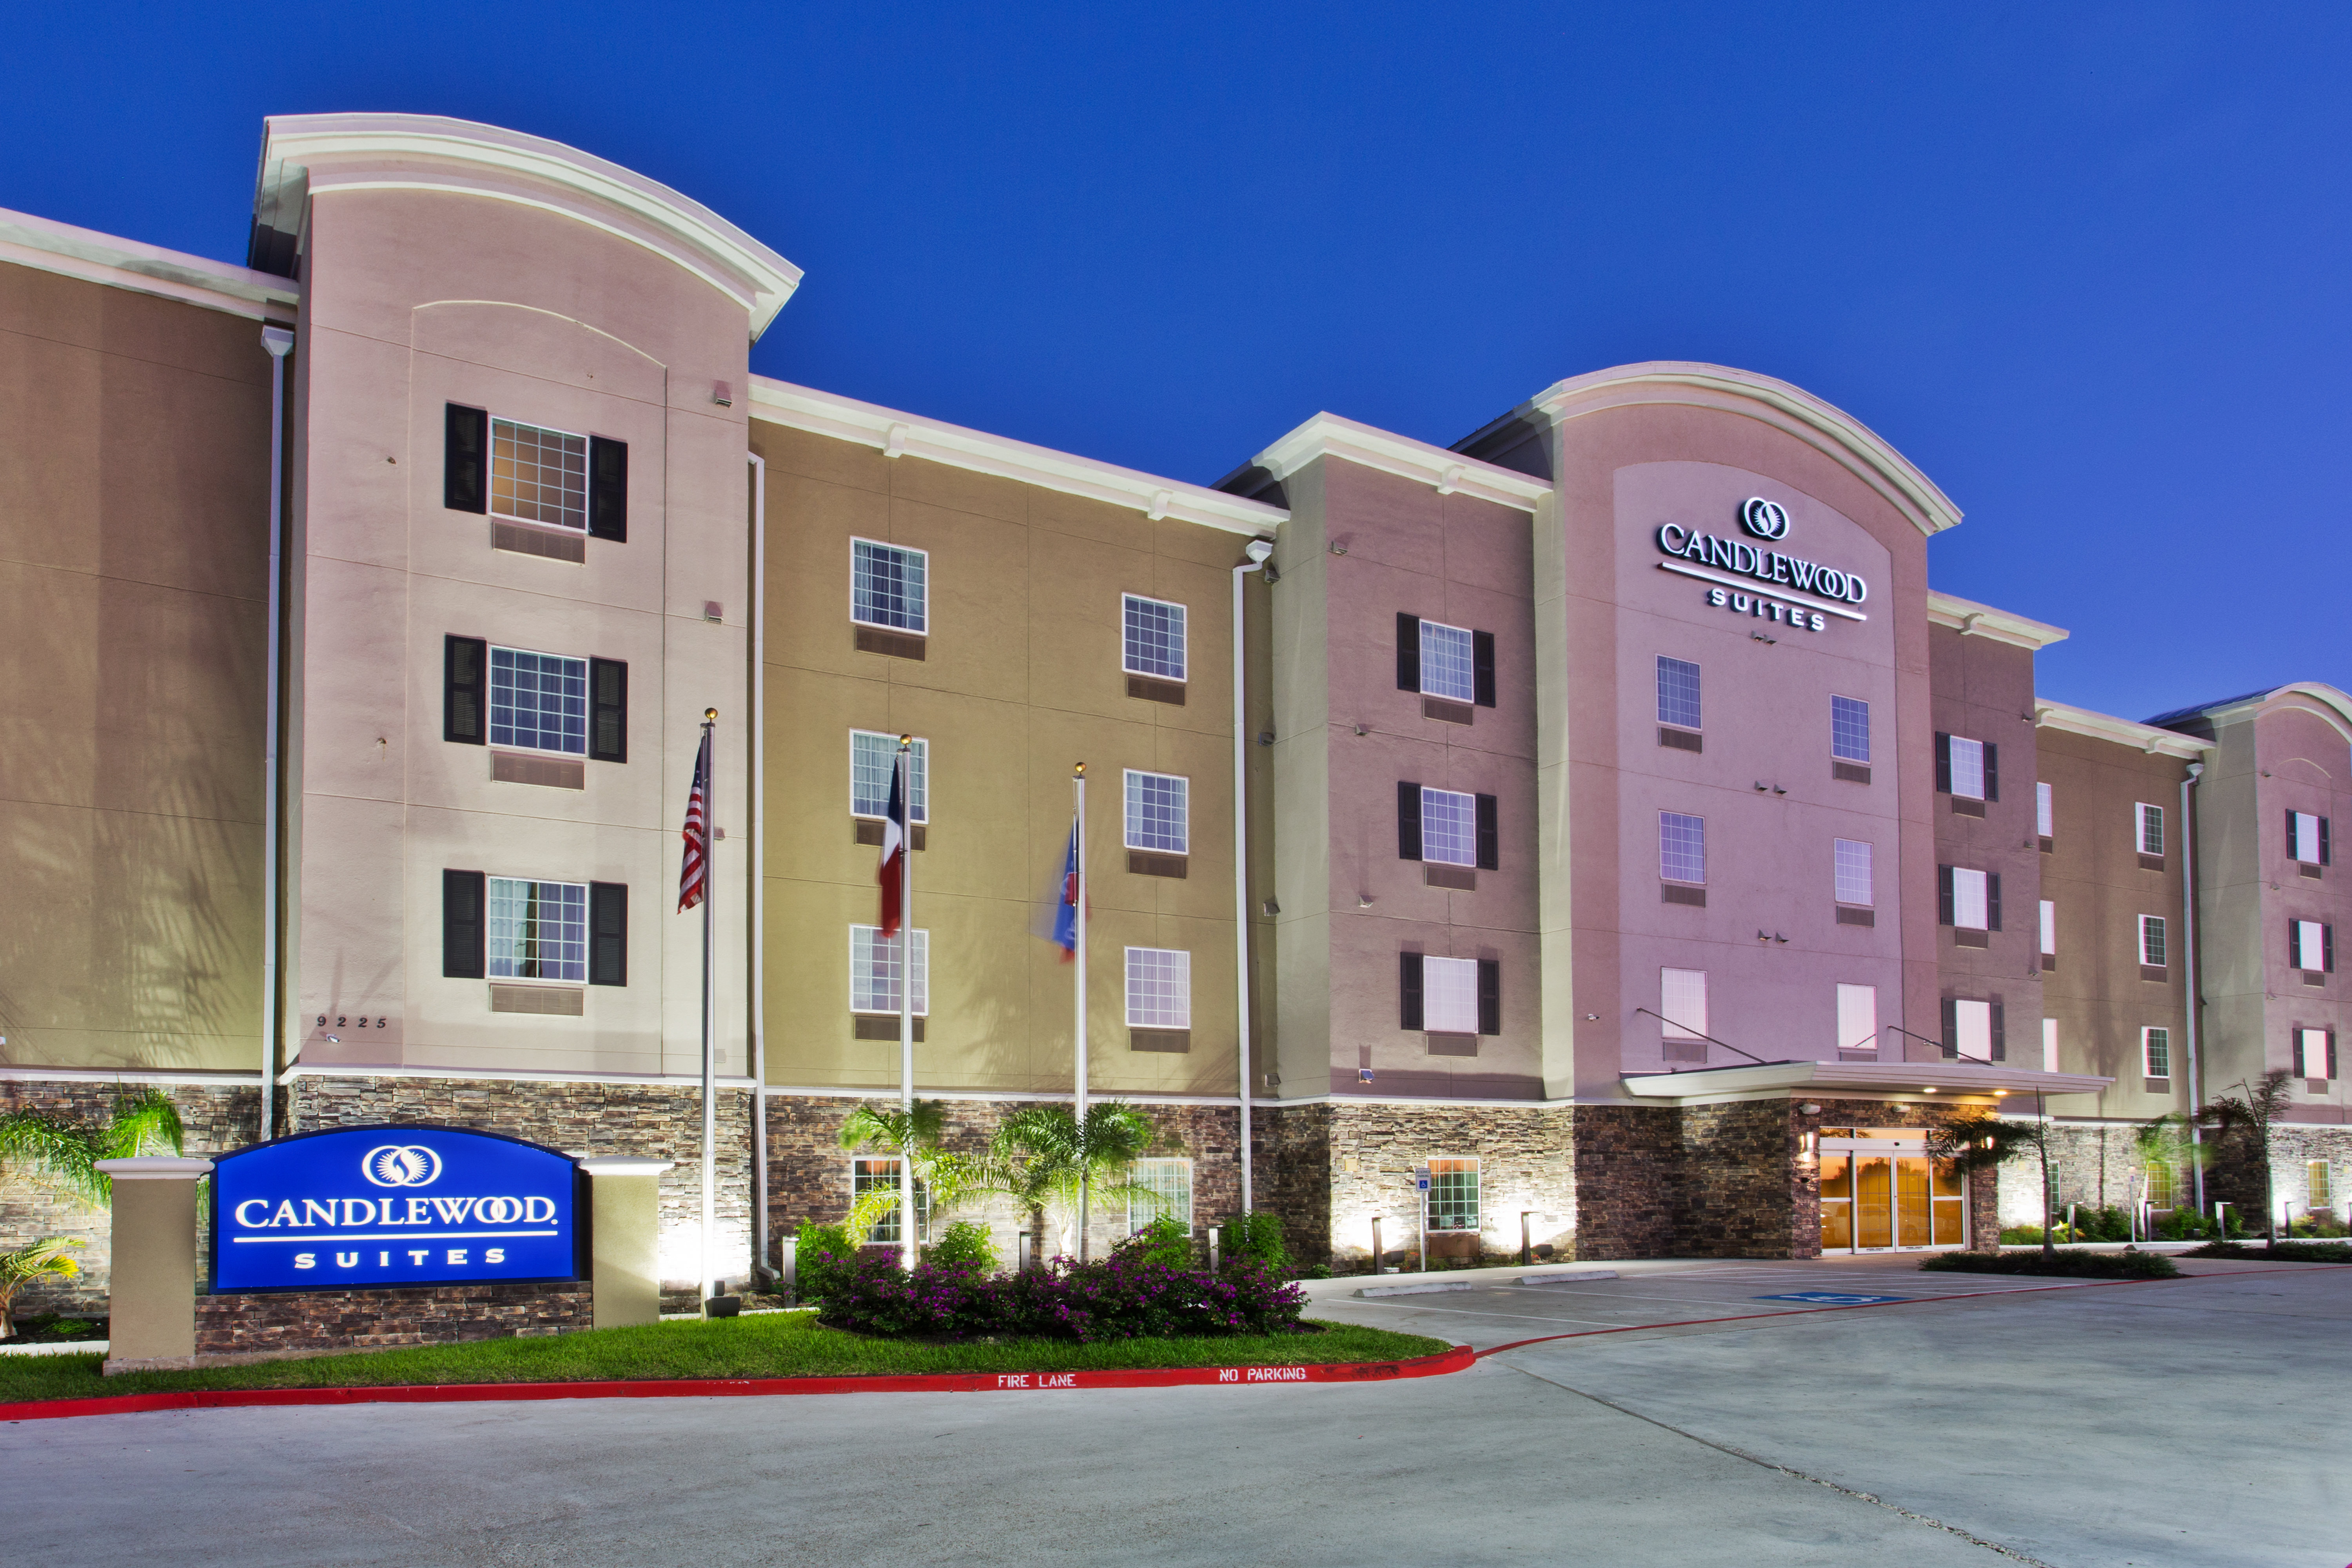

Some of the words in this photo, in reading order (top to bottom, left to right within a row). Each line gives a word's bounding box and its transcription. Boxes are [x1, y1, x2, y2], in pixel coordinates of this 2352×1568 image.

[1660, 523, 1867, 603] CANDLEWOOD
[1710, 588, 1825, 631] SUITES
[317, 1016, 387, 1028] 9225
[235, 1196, 556, 1228] CANDLEWOOD
[294, 1248, 505, 1269] SUITES
[998, 1374, 1029, 1387] FIRE
[1039, 1374, 1076, 1387] LANE
[1219, 1369, 1238, 1381] NO
[1247, 1367, 1306, 1381] PARKING
